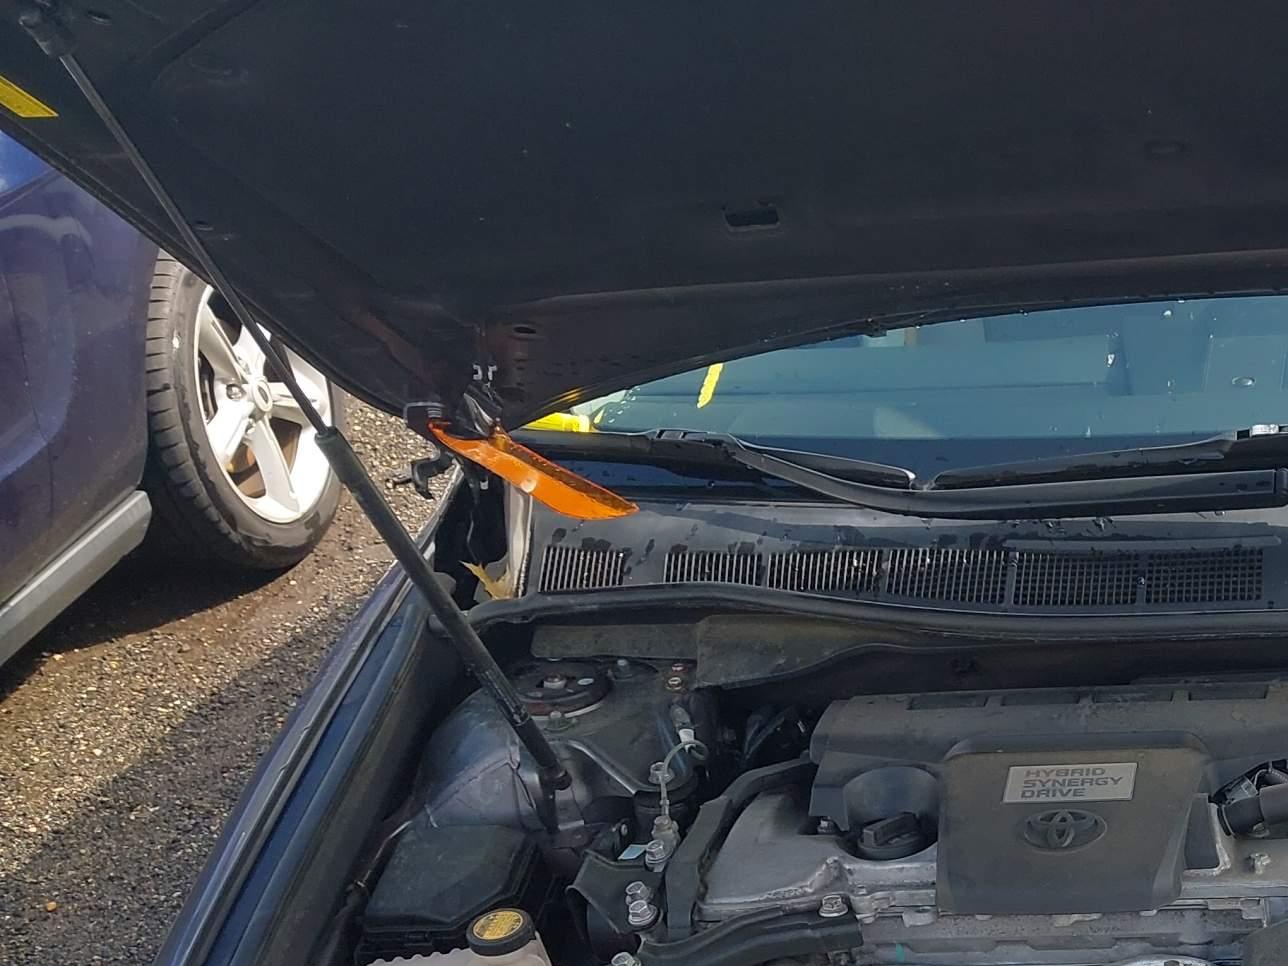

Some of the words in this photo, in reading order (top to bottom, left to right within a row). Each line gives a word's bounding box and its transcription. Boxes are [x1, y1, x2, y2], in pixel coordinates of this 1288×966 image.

[1025, 767, 1106, 778] HYBRID
[1023, 777, 1123, 788] SYNERGY
[1021, 788, 1086, 798] DRIVE
